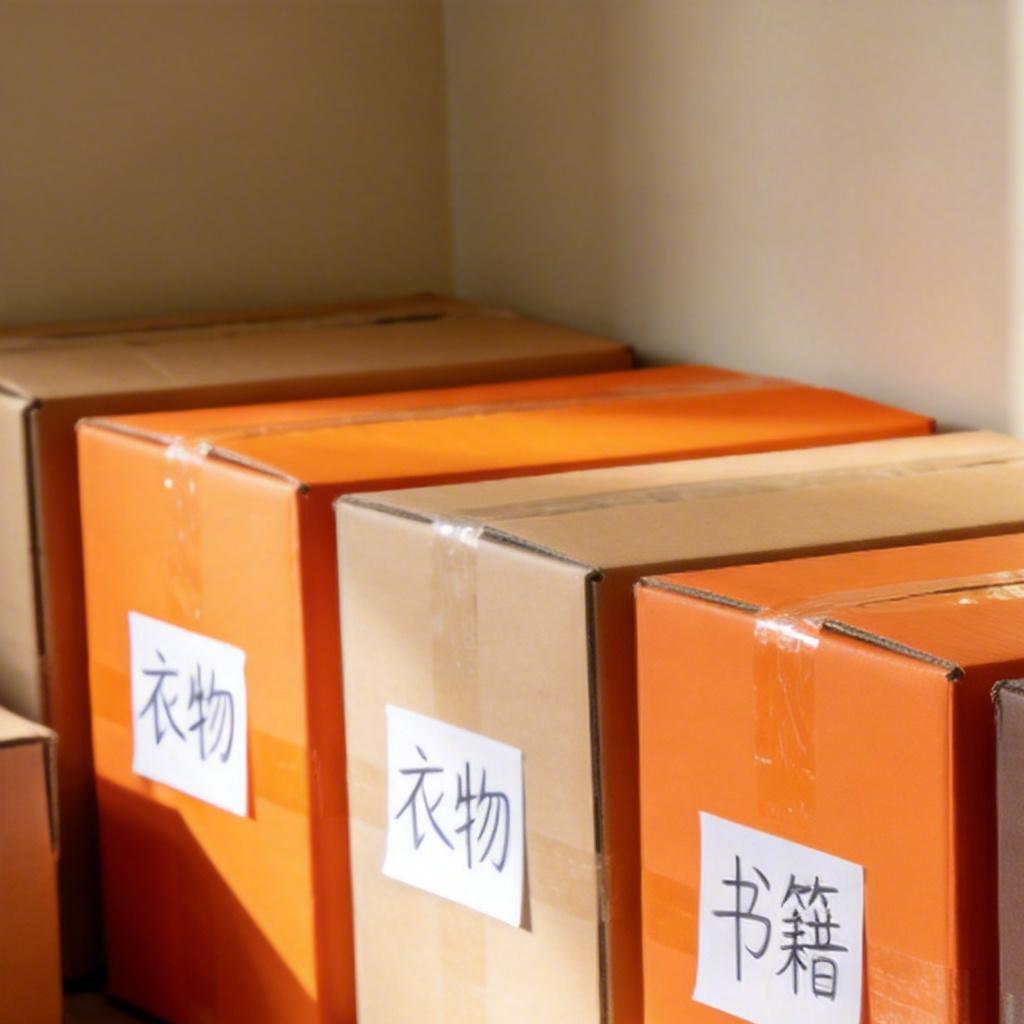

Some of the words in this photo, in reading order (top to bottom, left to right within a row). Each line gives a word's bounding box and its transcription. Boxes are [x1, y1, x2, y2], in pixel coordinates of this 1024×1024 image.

[138, 649, 236, 764] 衣物
[394, 744, 512, 873] 衣物
[711, 854, 850, 1002] 书籍
